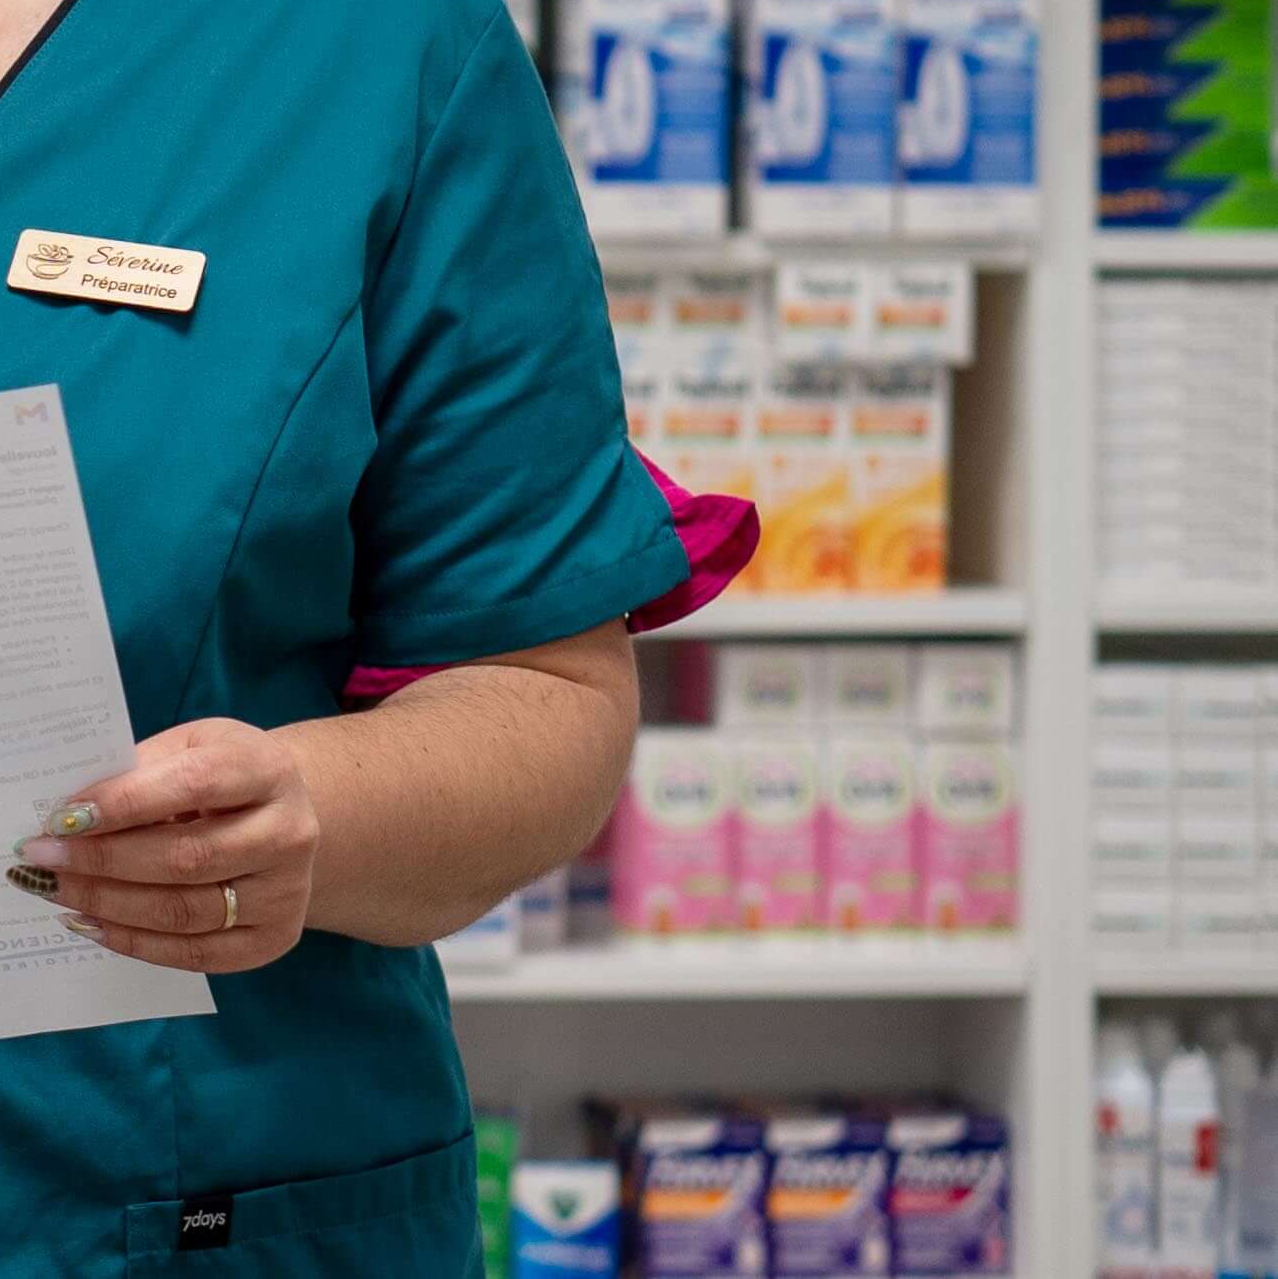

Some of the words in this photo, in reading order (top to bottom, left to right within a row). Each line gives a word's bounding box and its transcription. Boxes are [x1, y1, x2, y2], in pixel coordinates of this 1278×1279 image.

[87, 246, 185, 276] Séverine
[81, 274, 178, 299] Préparatrice
[183, 1210, 226, 1232] 7days
